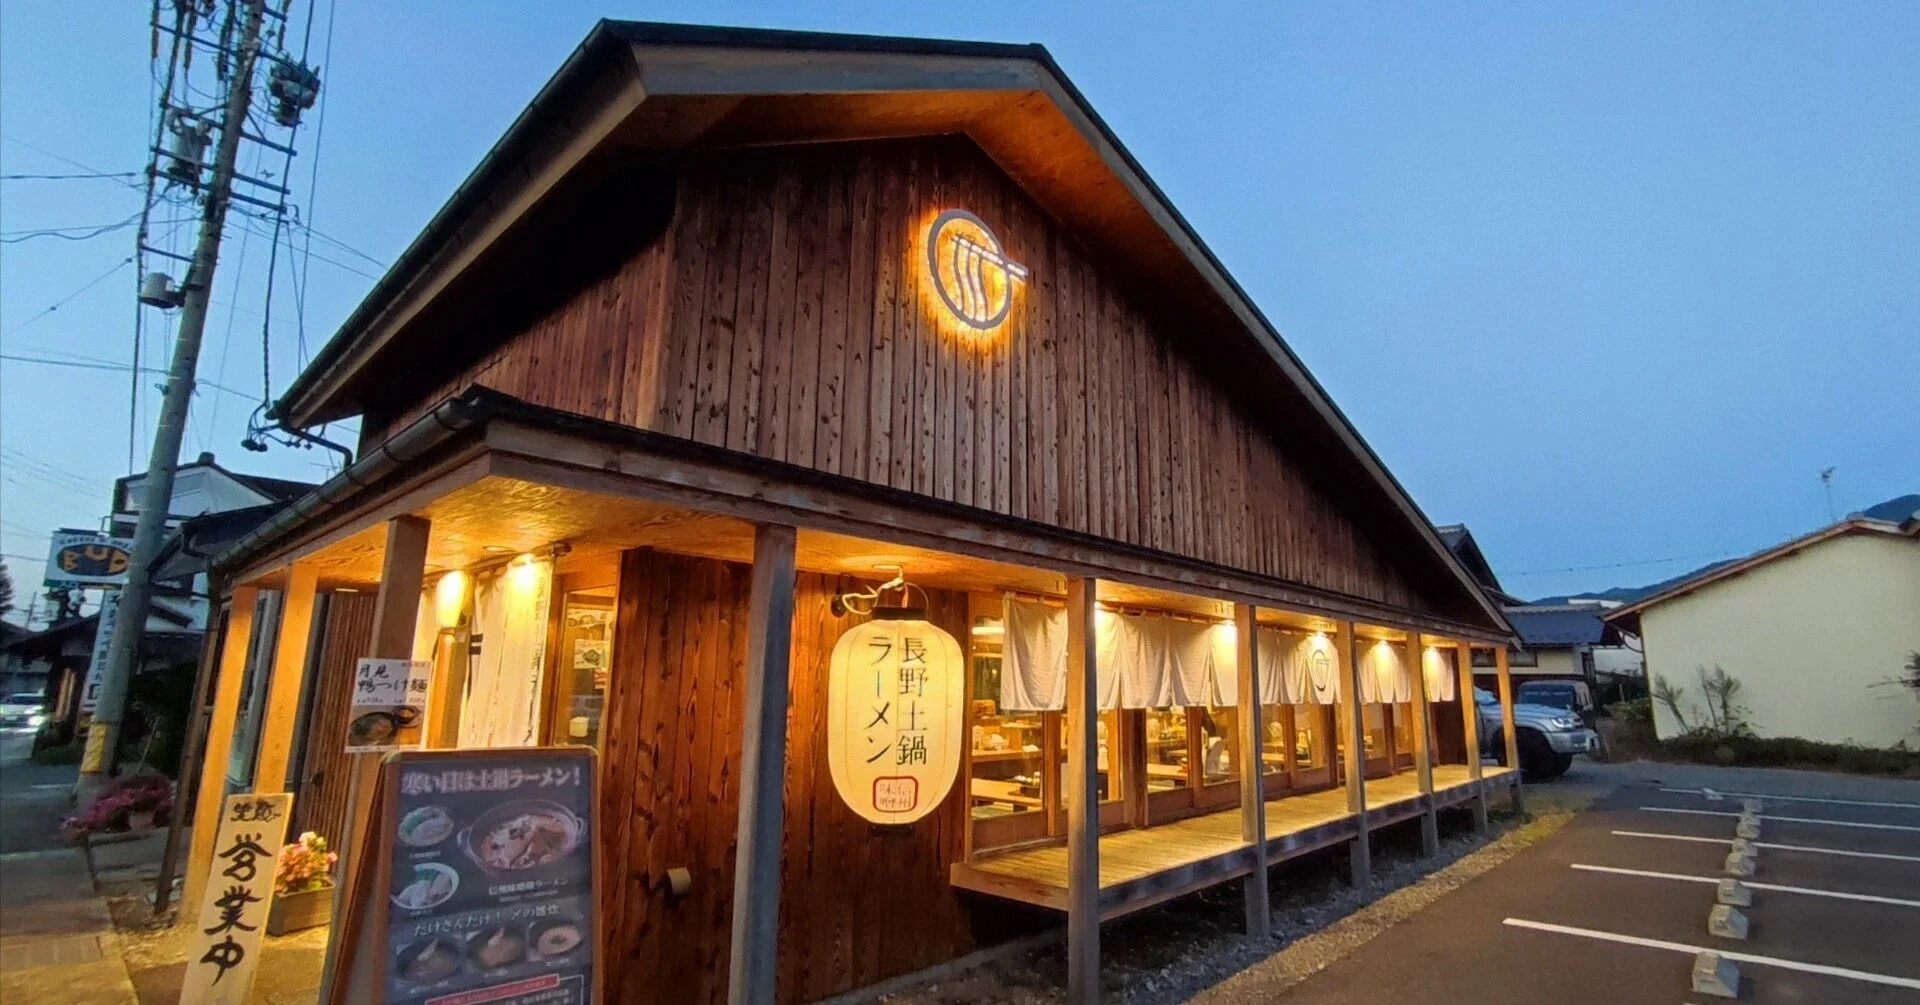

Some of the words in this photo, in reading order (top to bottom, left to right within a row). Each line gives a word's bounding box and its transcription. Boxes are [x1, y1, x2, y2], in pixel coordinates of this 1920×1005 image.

[358, 678, 428, 694] 鴨つけ麺
[864, 636, 894, 764] ラーメン
[897, 636, 928, 767] 長野土鍋
[200, 832, 274, 987] 営業中
